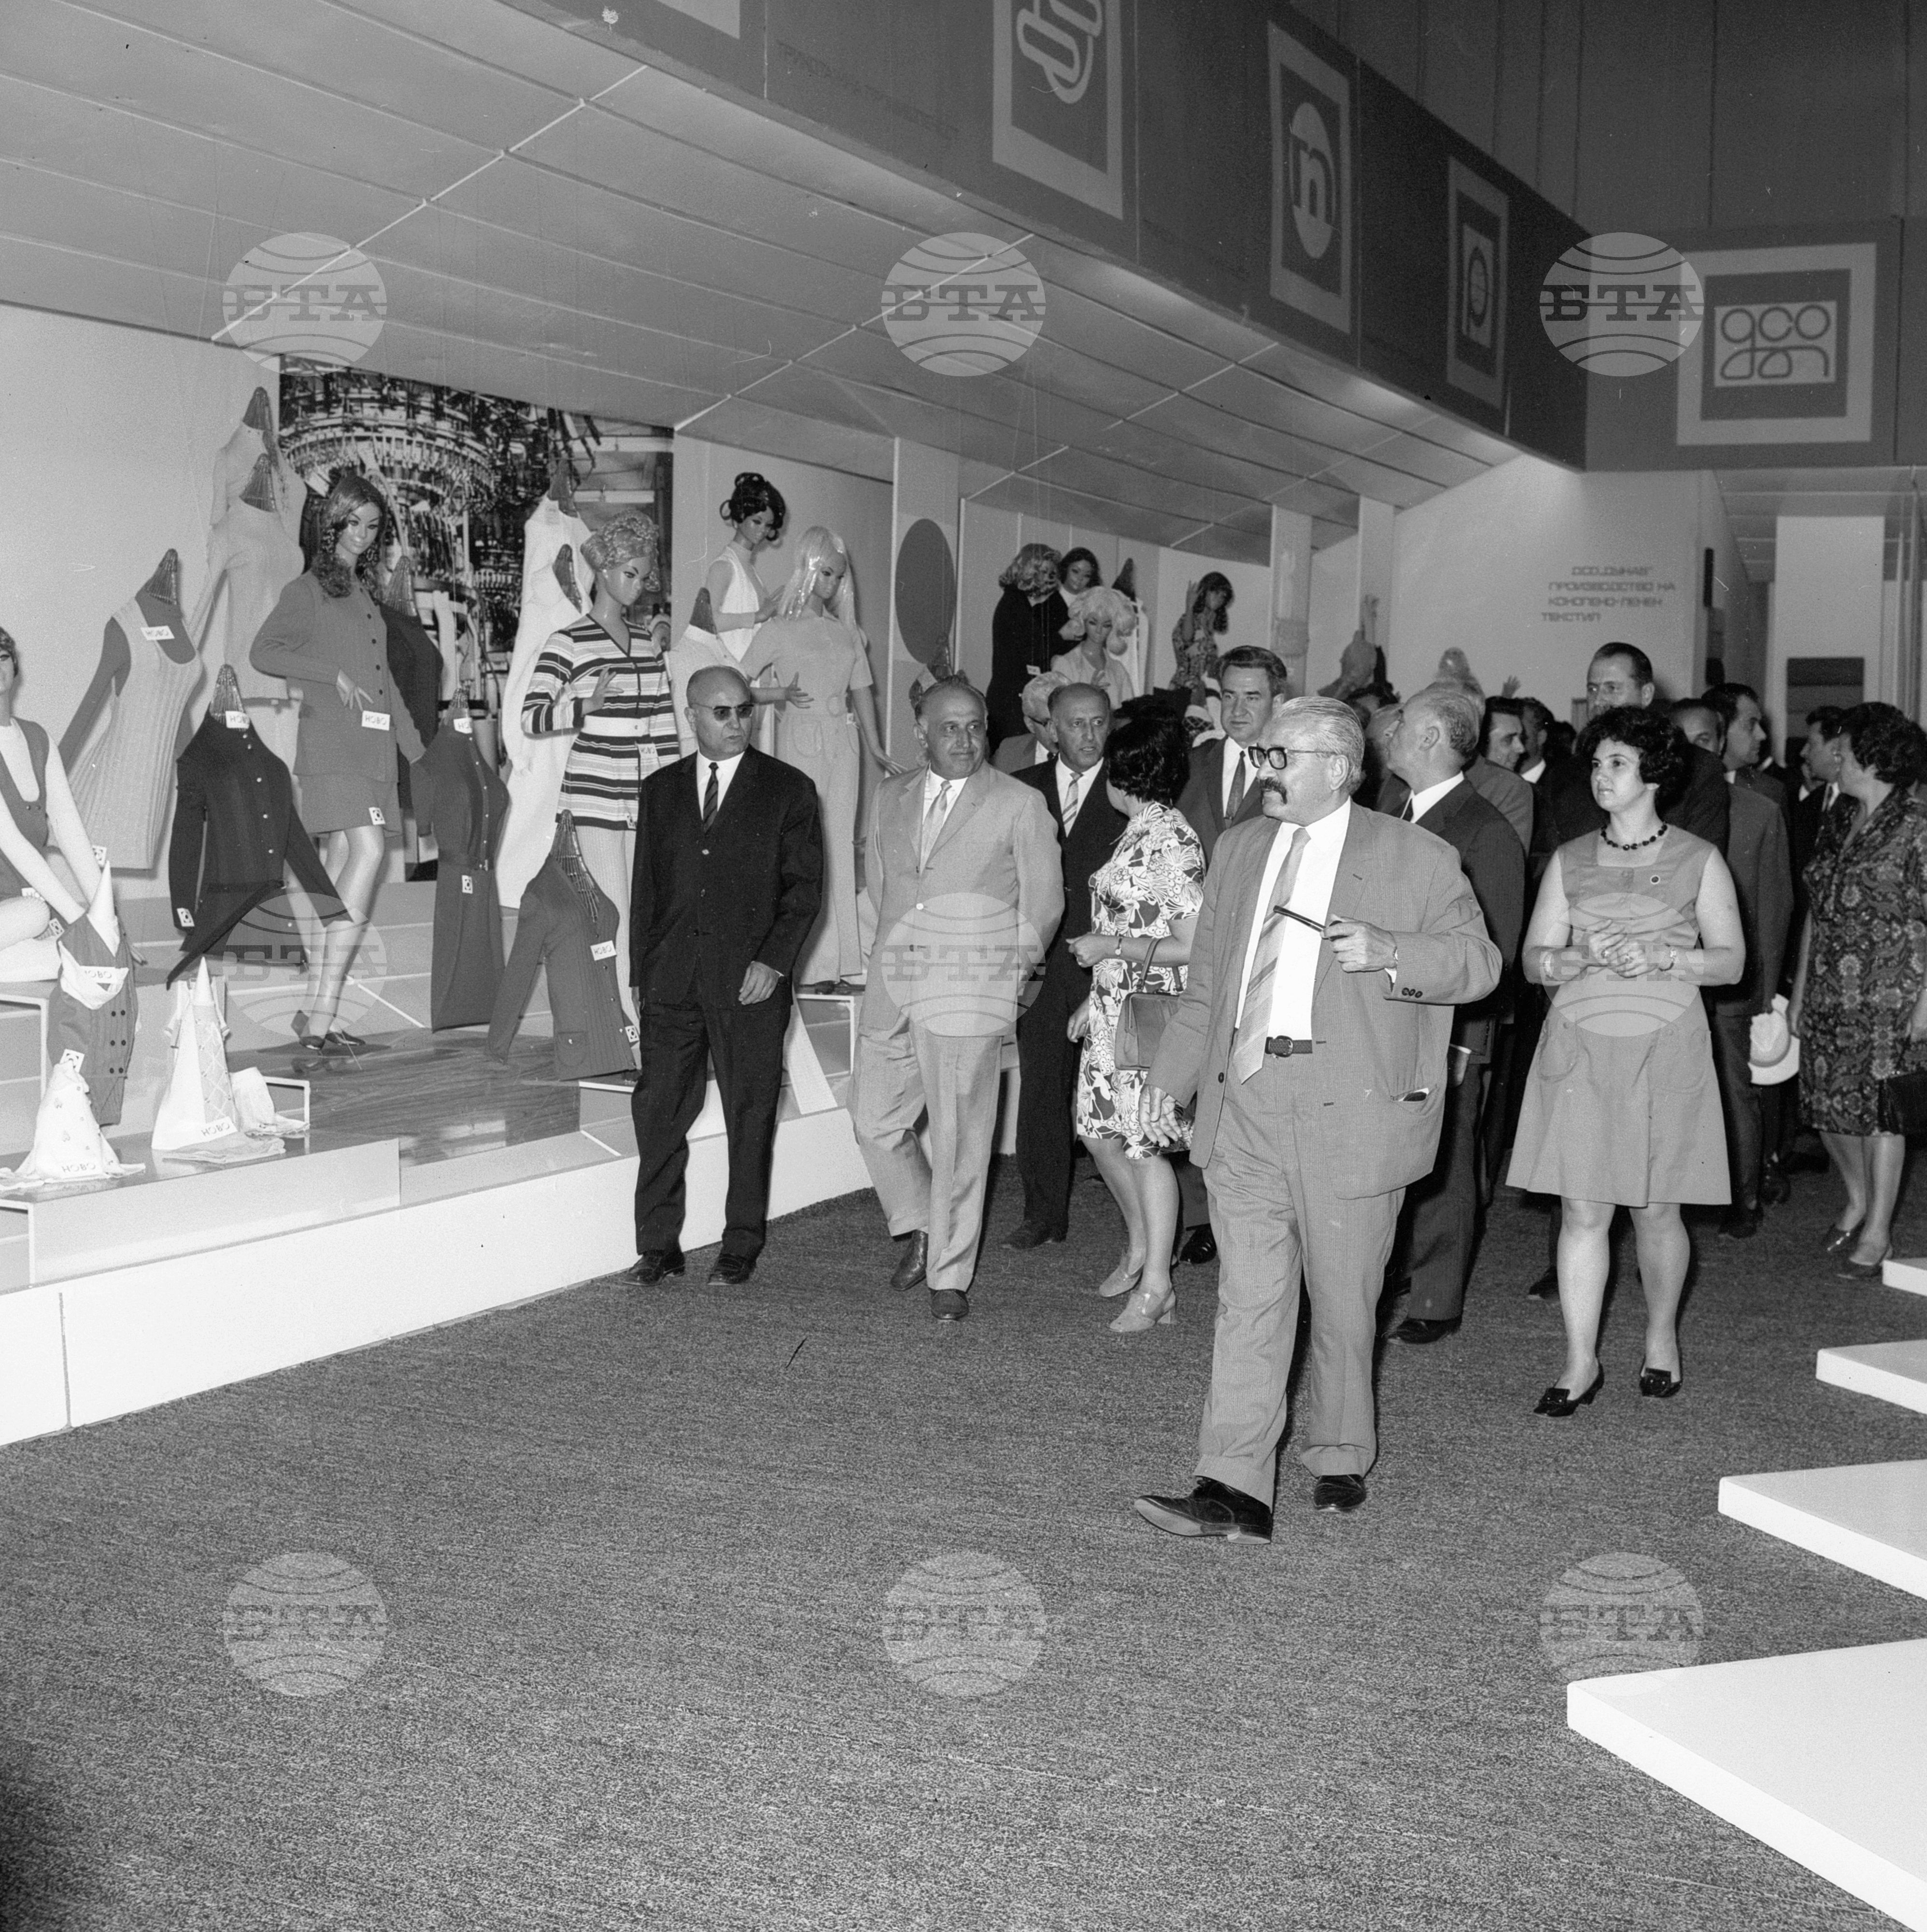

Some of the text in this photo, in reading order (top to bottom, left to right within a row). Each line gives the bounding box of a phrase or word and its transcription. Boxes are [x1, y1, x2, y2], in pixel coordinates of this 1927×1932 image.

[1657, 582, 1676, 591] НА
[1542, 612, 1601, 622] ТЕКСТИЛ
[365, 714, 387, 725] НОВО
[594, 945, 612, 955] НОВО
[201, 1122, 230, 1136] НОВО
[61, 1163, 96, 1173] НОВО
